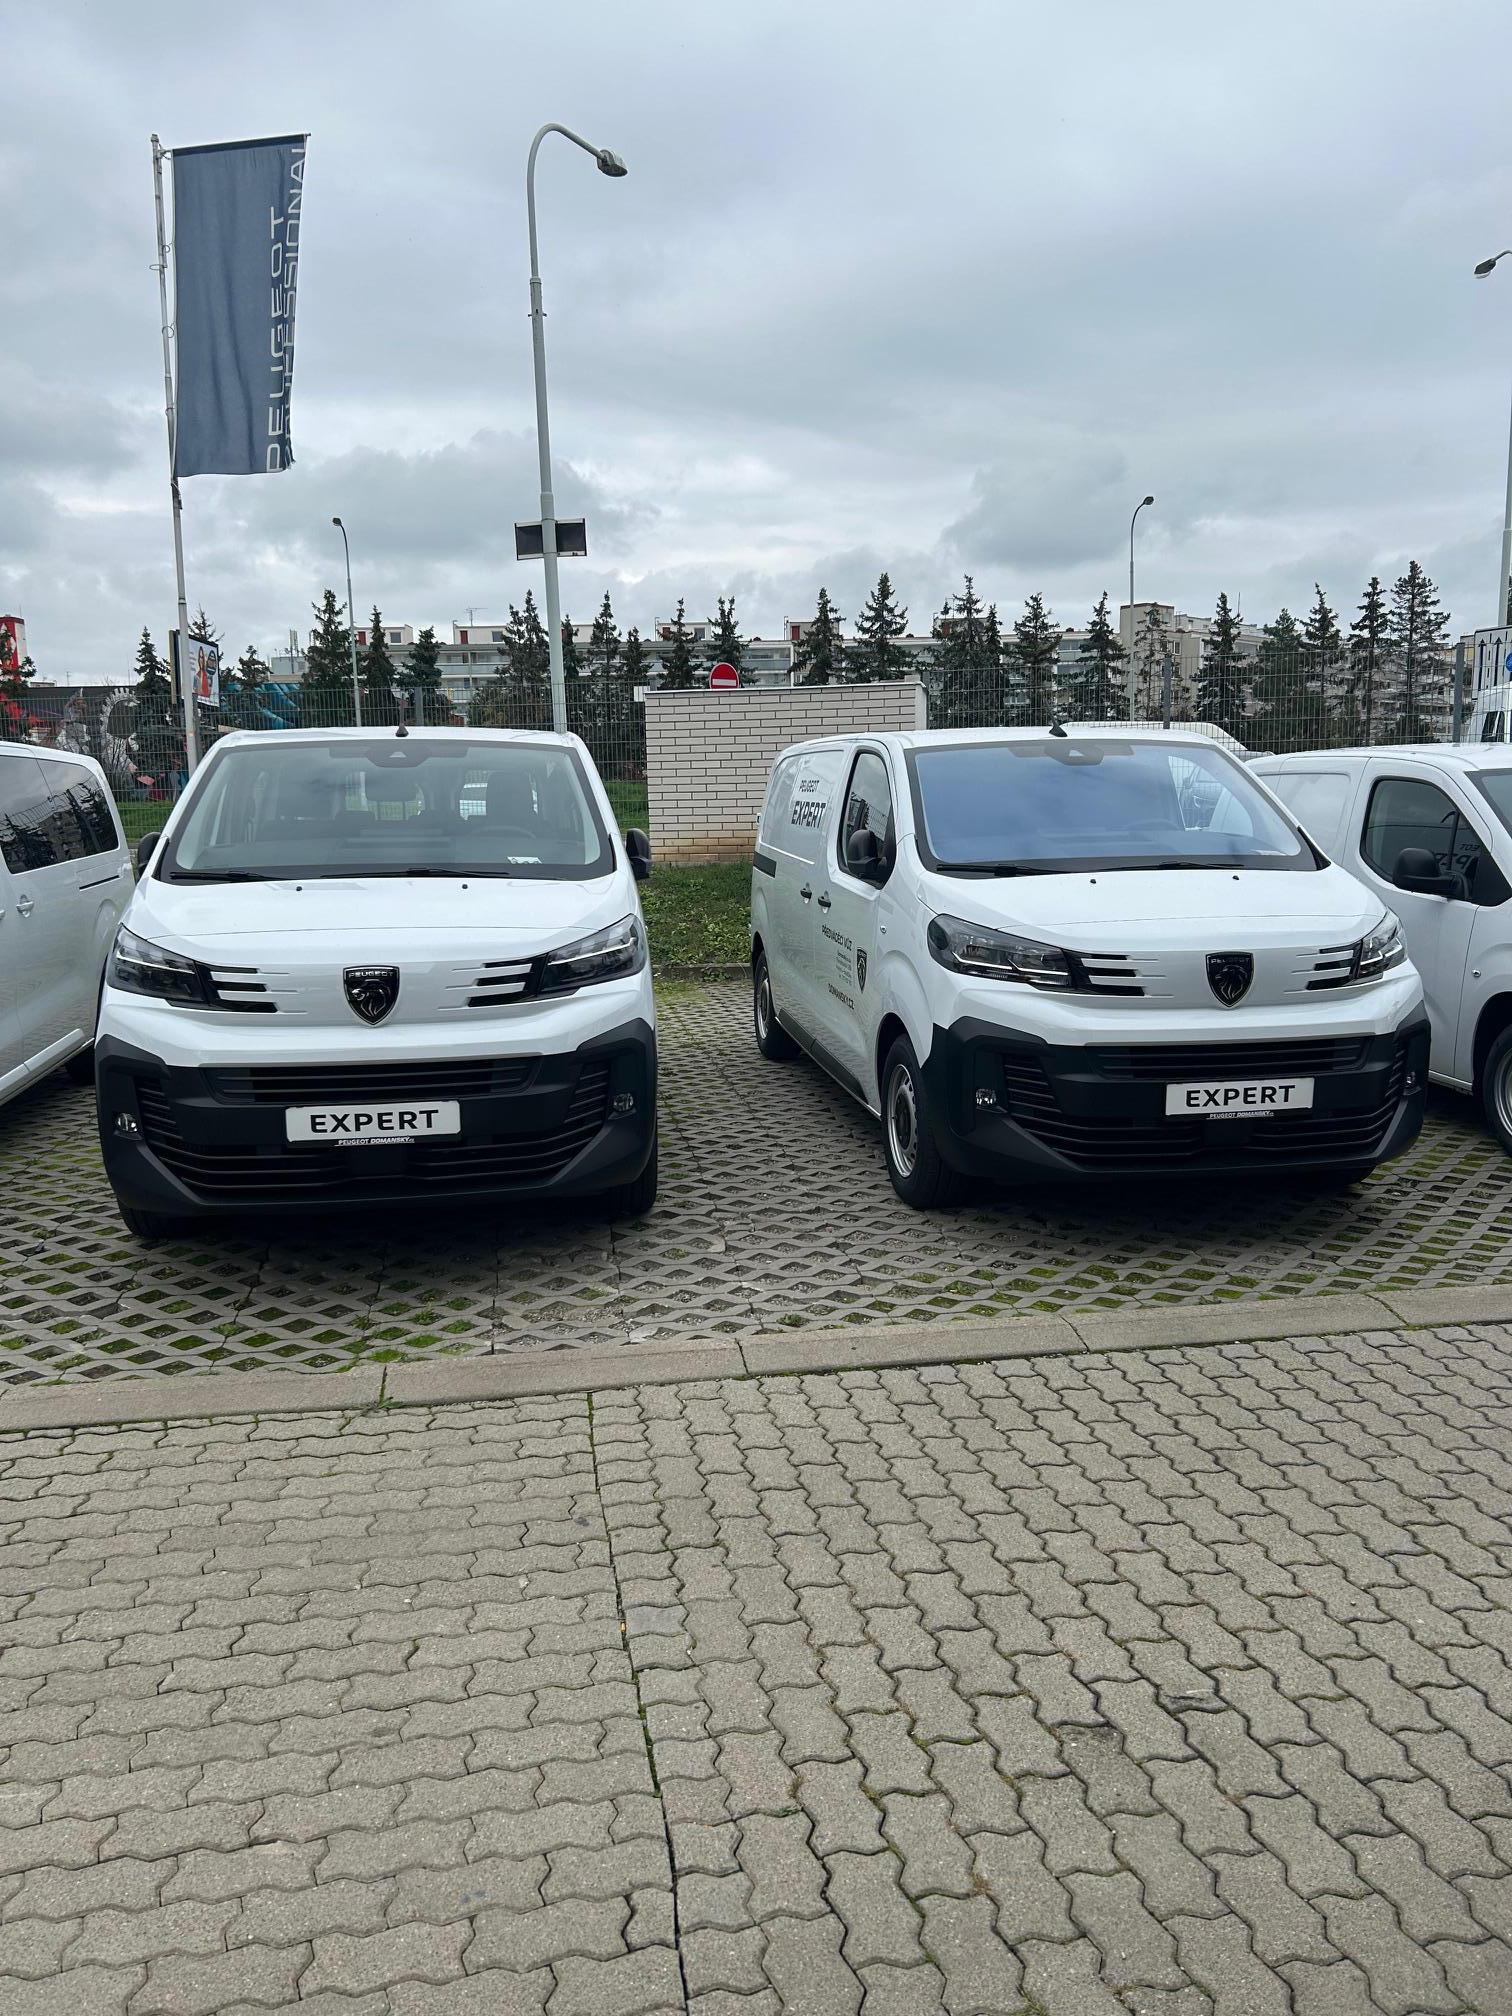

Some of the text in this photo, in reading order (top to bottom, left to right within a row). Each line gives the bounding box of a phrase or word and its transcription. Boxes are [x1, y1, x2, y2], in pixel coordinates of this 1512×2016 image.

[266, 206, 285, 473] PEUGEOT
[791, 800, 827, 829] EXPERT
[348, 970, 394, 979] PEUGEOT
[1185, 1084, 1296, 1108] EXPERT
[310, 1109, 440, 1134] EXPERT
[338, 1138, 369, 1146] PEUGEOT
